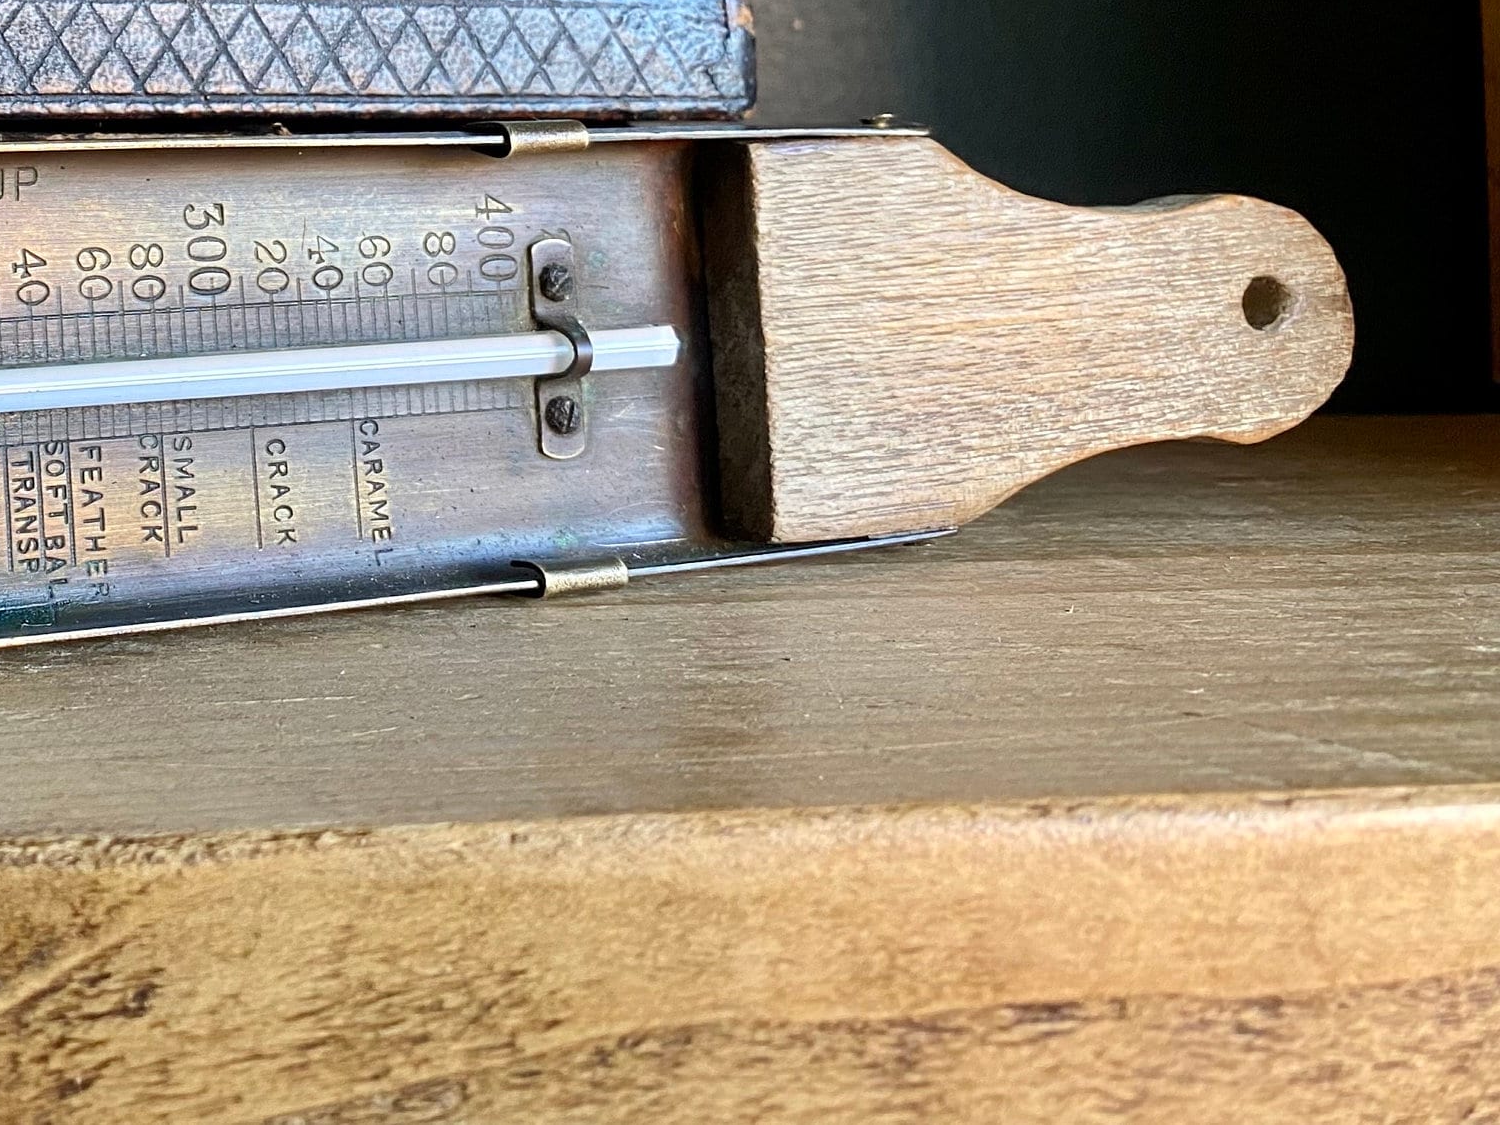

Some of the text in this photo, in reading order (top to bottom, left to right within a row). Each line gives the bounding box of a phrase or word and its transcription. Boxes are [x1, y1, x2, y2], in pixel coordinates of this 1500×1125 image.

[11, 248, 51, 306] 40
[76, 246, 113, 301] 60
[128, 242, 167, 302] 80
[182, 201, 233, 296] 300
[253, 239, 291, 295] 20
[307, 233, 344, 291] 40
[357, 233, 394, 287] 60
[421, 230, 459, 287] 80
[474, 192, 519, 283] 400
[10, 451, 42, 574] TRANSP
[44, 441, 70, 526] SOFT
[78, 445, 112, 598] FEATHER
[137, 434, 164, 543] CRACK
[173, 435, 199, 544] SMALL
[265, 437, 298, 546] CRACK
[358, 419, 394, 567] CARAMEL
